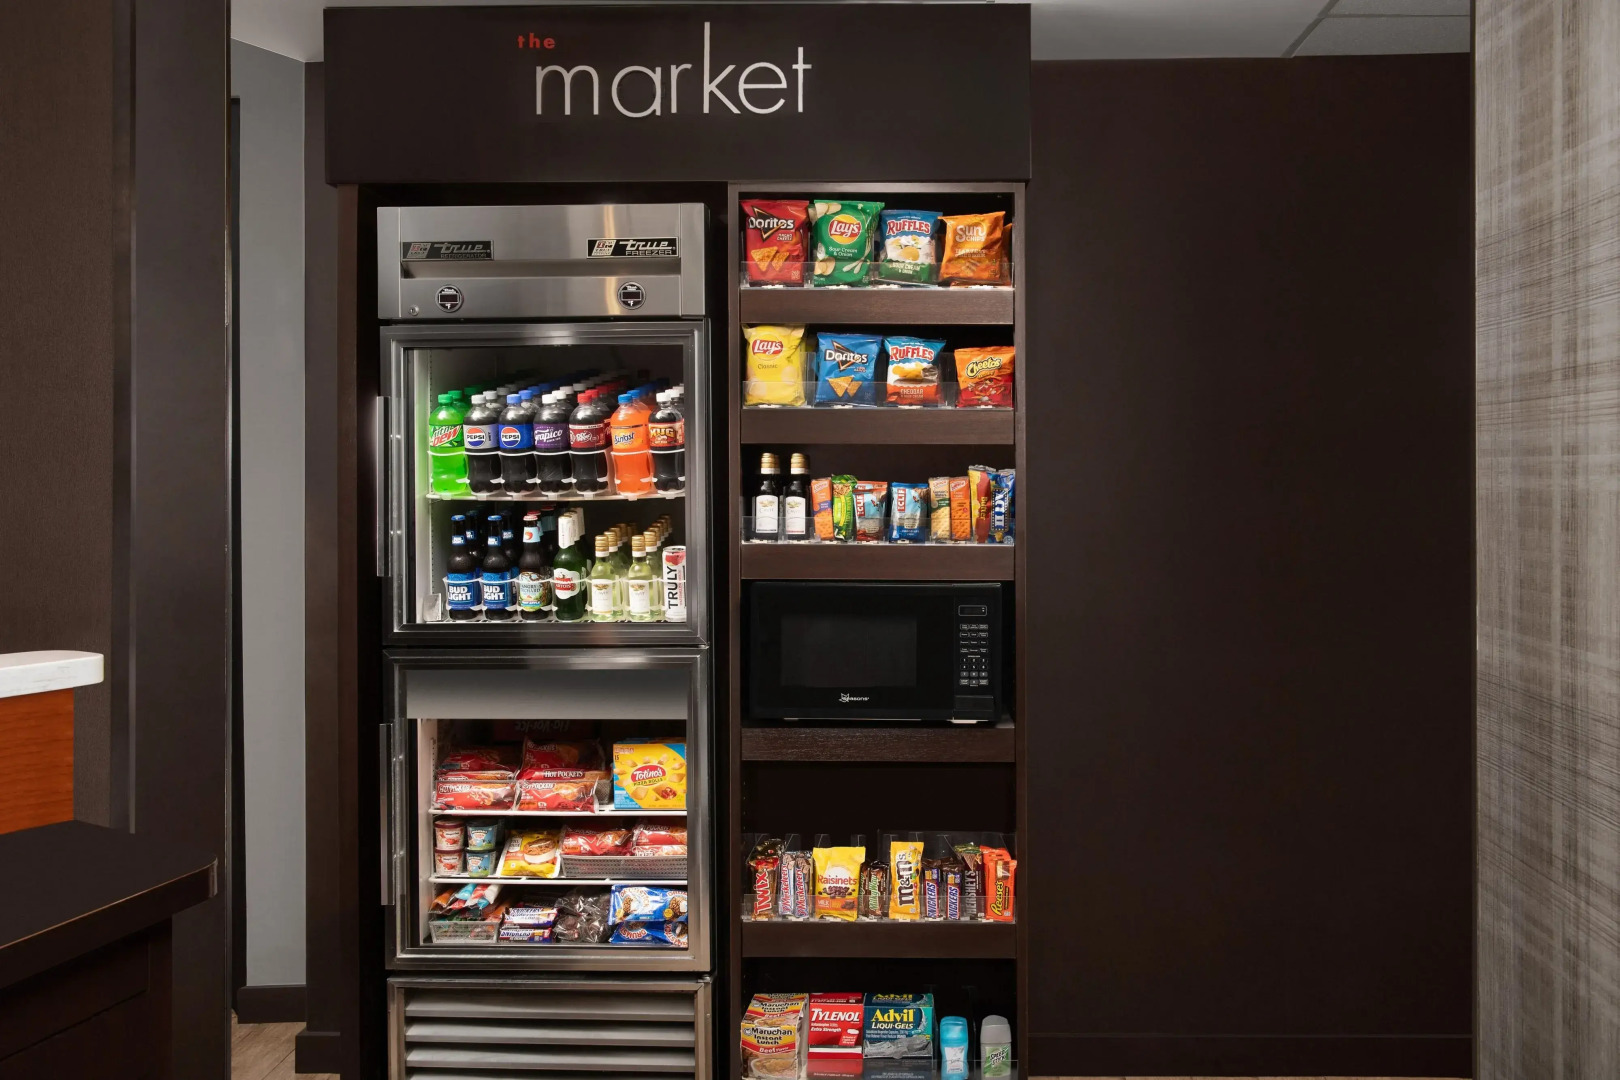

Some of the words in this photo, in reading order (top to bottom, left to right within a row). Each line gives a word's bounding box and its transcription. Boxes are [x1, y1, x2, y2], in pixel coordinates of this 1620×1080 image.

[517, 33, 556, 49] the
[536, 21, 812, 118] market
[748, 217, 795, 230] Doritos
[830, 220, 860, 238] Lay's
[886, 219, 931, 236] RUFFLES
[619, 240, 676, 251] true
[754, 339, 782, 355] Lay's
[889, 346, 935, 362] RUFFLES
[825, 349, 868, 364] Doritos
[965, 356, 1002, 379] Cheetos
[897, 488, 906, 507] CLIF
[449, 585, 468, 594] BUD
[666, 566, 678, 609] TRULY
[633, 769, 663, 781] Totino's
[817, 875, 858, 886] Raisinets
[926, 882, 938, 919] SNICKERS
[965, 870, 977, 915] HERSHEY'S
[990, 880, 1004, 916] Reese's
[947, 886, 959, 920] SNICKERS
[811, 1008, 861, 1022] TYLENOL
[872, 1008, 915, 1023] Advil
[751, 1027, 793, 1036] Maruchan
